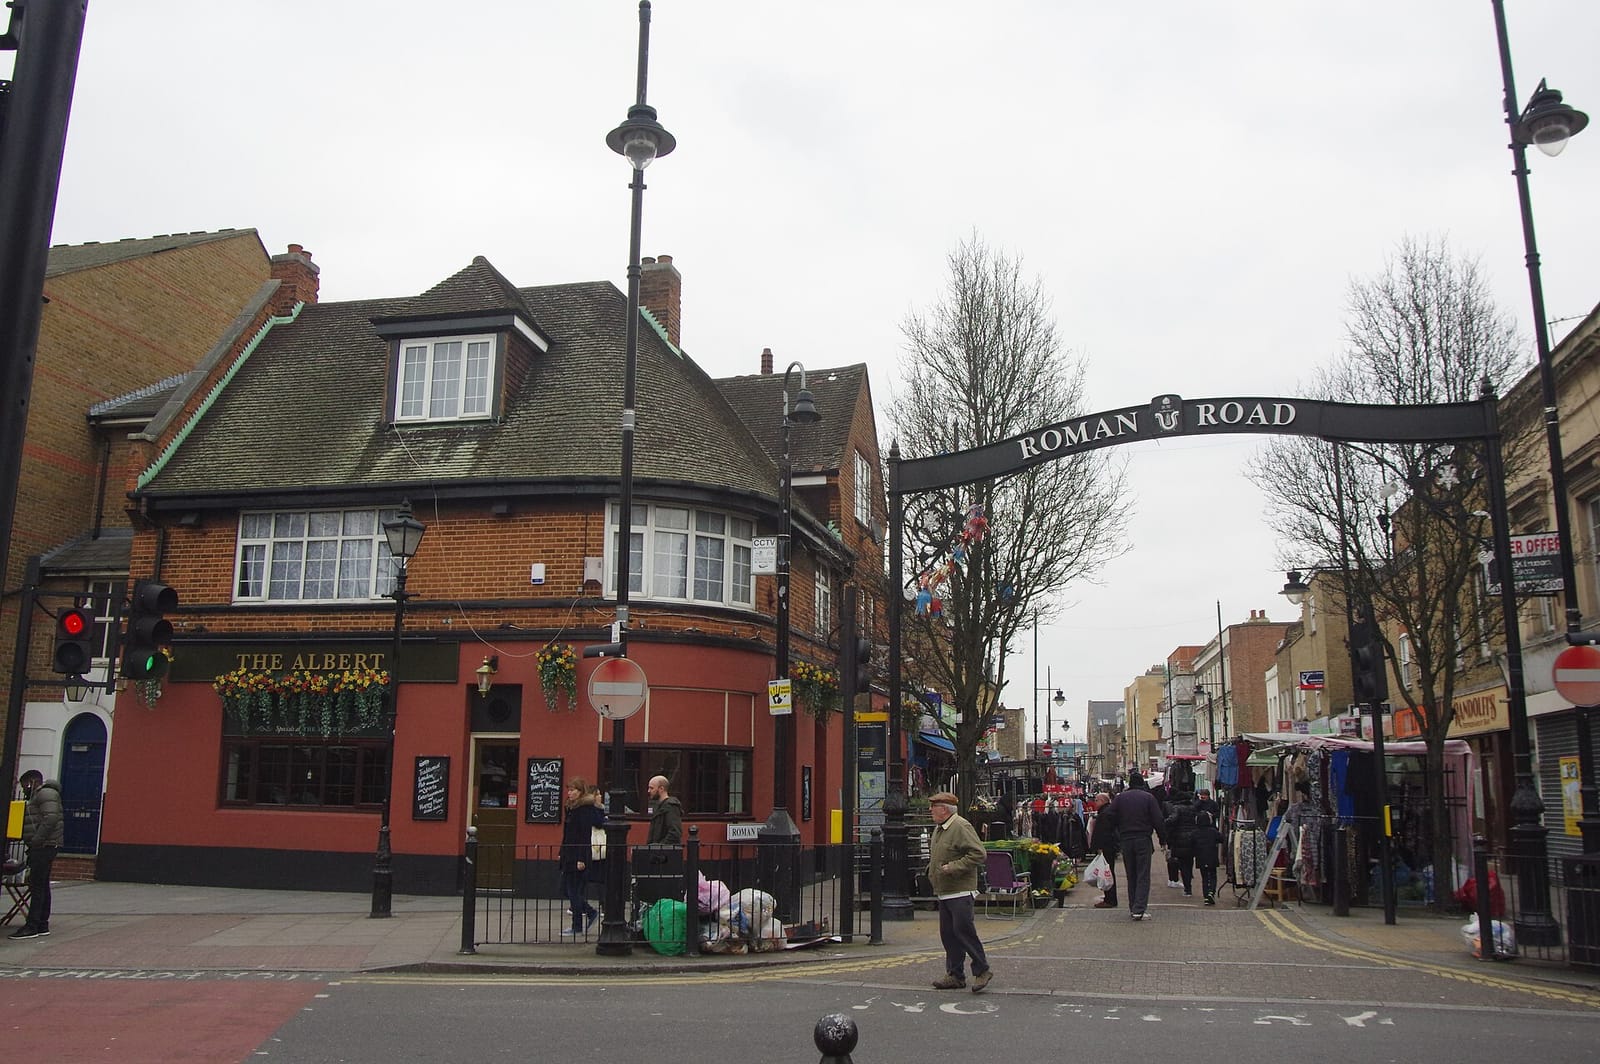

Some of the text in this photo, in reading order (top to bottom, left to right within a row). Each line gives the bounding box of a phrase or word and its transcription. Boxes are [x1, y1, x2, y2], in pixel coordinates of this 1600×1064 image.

[1017, 402, 1296, 461] ROMAN ROAD
[753, 539, 776, 547] CCTV
[236, 653, 385, 670] THE ALBERT
[1060, 799, 1070, 807] £5
[732, 828, 756, 837] ROMAN
